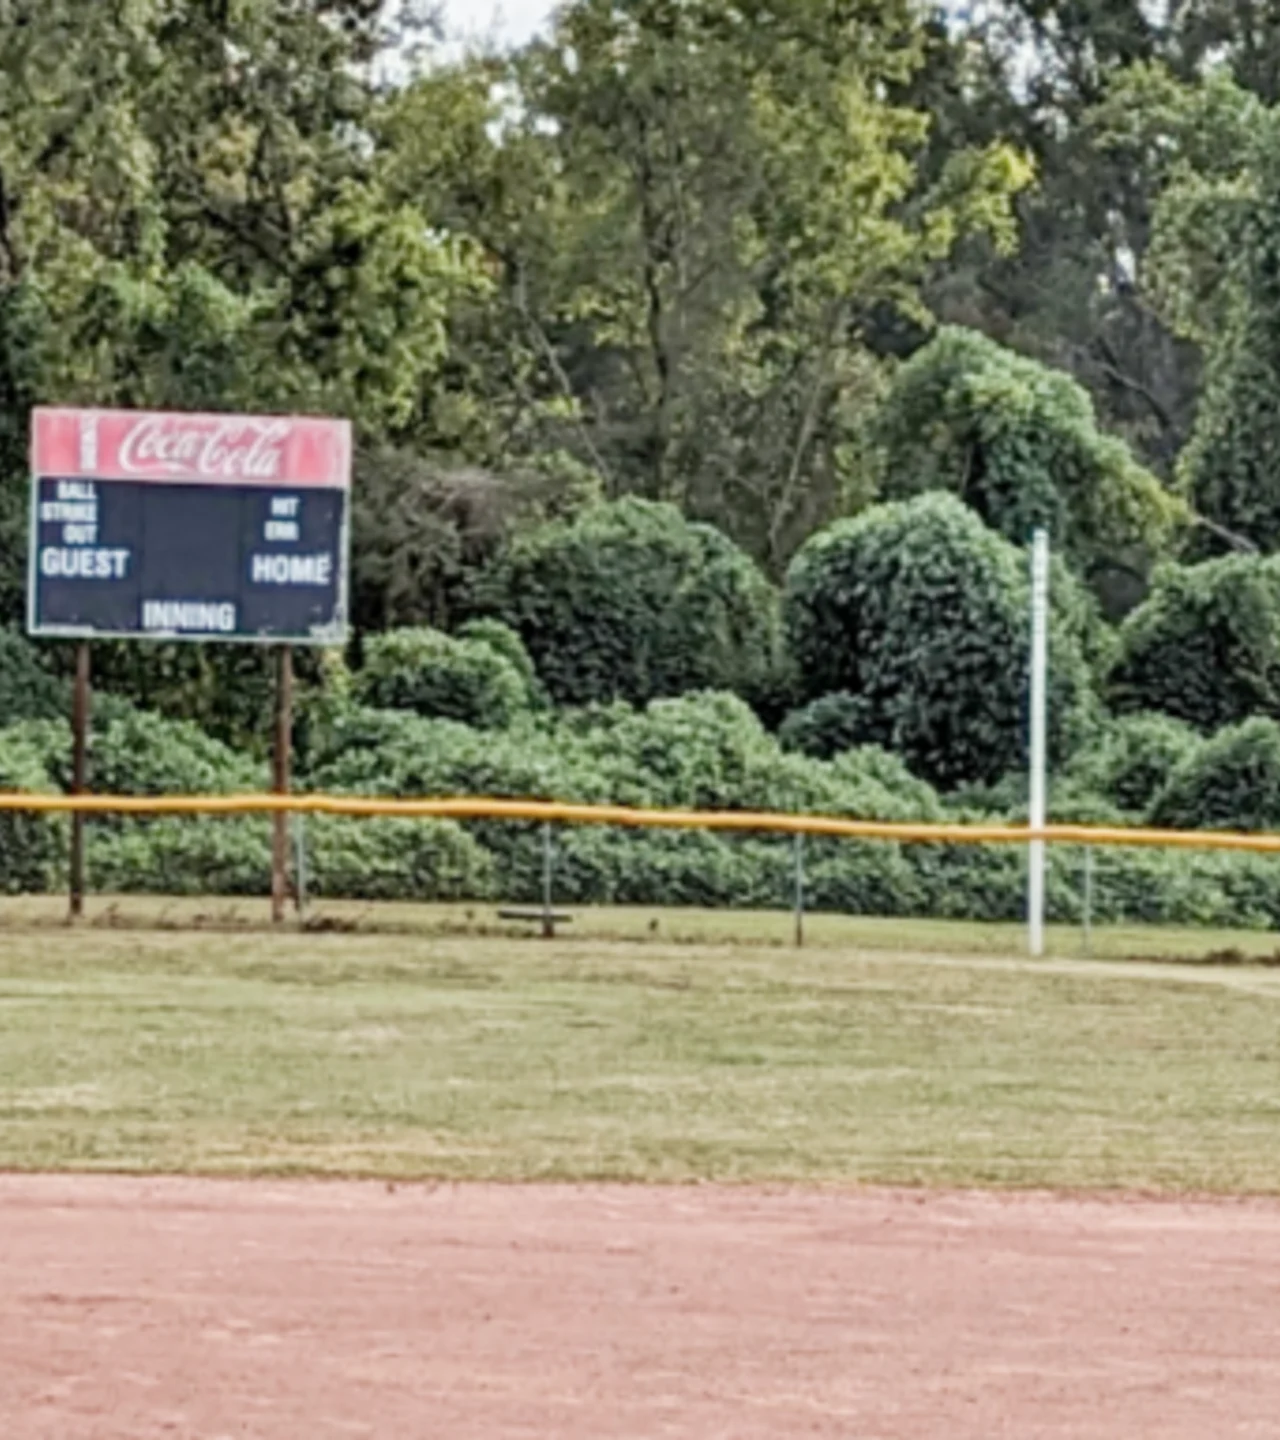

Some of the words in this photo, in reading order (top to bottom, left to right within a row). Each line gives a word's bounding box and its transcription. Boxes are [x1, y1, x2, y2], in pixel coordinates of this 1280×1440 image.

[57, 480, 97, 500] BALL
[41, 502, 97, 521] STRIKE
[271, 496, 299, 516] HIT
[63, 524, 98, 544] OUT
[41, 547, 131, 578] GUEST
[252, 553, 331, 585] HOME
[143, 600, 236, 630] INNING
